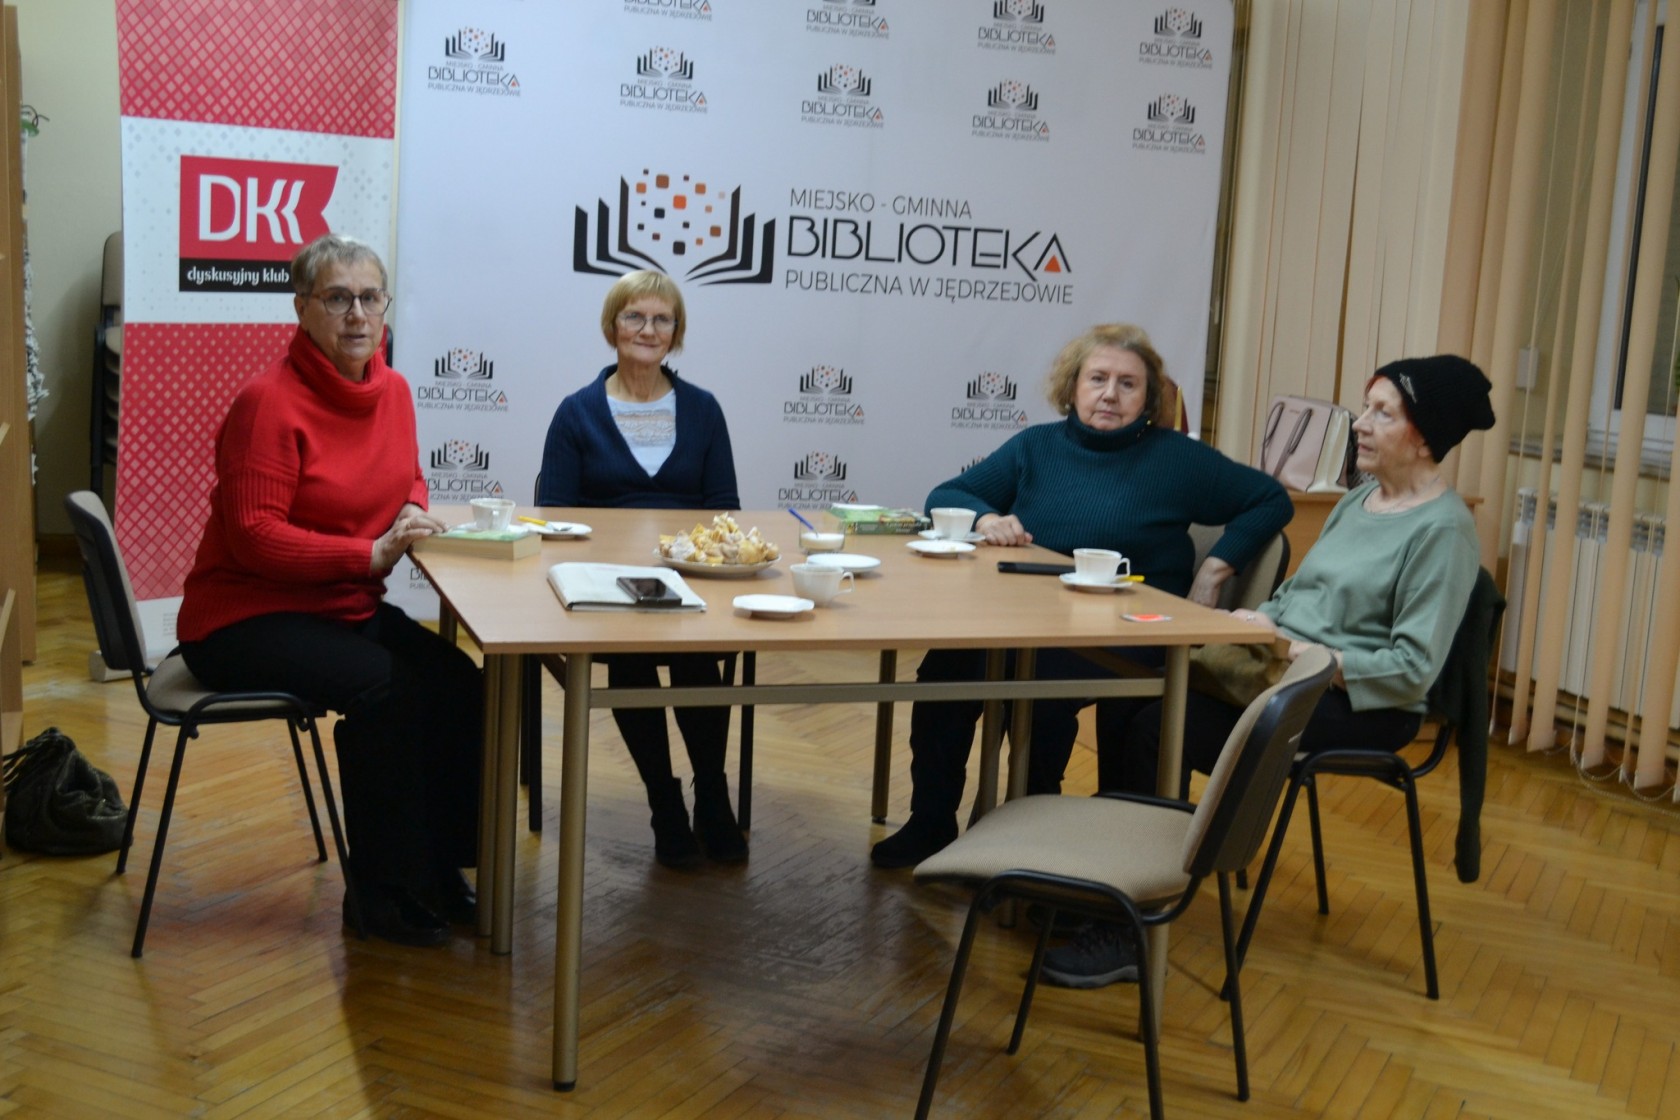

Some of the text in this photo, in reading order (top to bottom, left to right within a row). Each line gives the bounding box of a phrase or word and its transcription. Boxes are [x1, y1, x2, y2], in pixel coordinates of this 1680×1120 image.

[624, 0, 712, 13] OTEKA
[806, 9, 889, 32] BIBLIOTEKA
[978, 26, 1056, 49] BIBLIOTEKA
[1139, 42, 1213, 64] BIBLIOTEKA
[428, 66, 520, 92] BIBLIOTEKA
[620, 83, 707, 106] BIBLIOTEKA
[802, 100, 884, 122] BIBLIOTEKA
[973, 115, 1050, 136] BIBLIOTEKA
[1132, 127, 1206, 150] BIBLIOTEKA
[789, 188, 875, 213] MIEJSKO
[892, 195, 973, 219] GMINNA
[787, 215, 1072, 282] BIBLIOTEKA
[187, 266, 290, 286] dyskusyjny klub
[785, 269, 1073, 305] PUBLICZNA W JĘDRZEJOWIE
[417, 386, 508, 406] BIBLIOTEKA
[784, 401, 864, 420] BIBLIOTEKA
[952, 407, 1028, 427] BIBLIOTEKA
[427, 478, 504, 496] BLIOTEKA
[778, 488, 859, 503] BIBLIOTEKA
